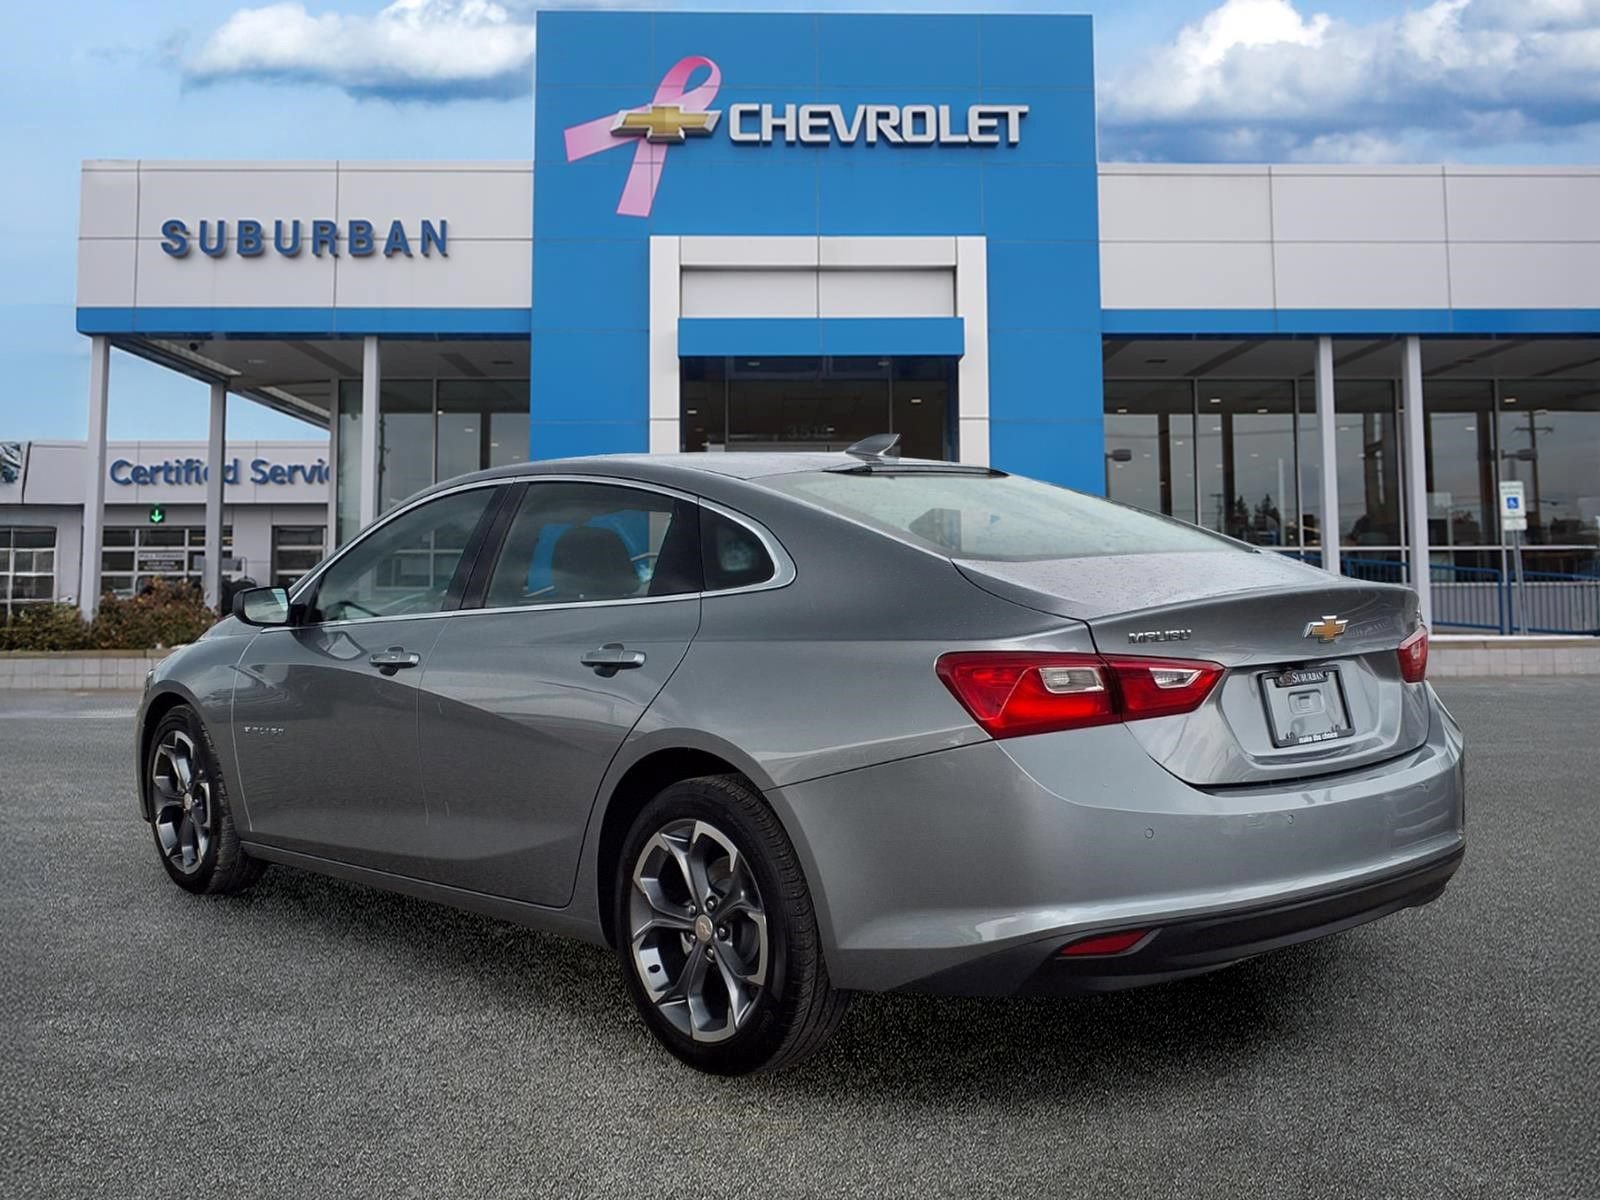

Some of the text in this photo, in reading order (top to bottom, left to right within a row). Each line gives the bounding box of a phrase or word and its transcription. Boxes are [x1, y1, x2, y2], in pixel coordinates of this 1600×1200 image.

[728, 102, 1030, 144] CHEVROLET
[160, 218, 450, 257] SUBURBAN
[250, 458, 330, 485] Servi
[1128, 628, 1192, 644] MALIBU
